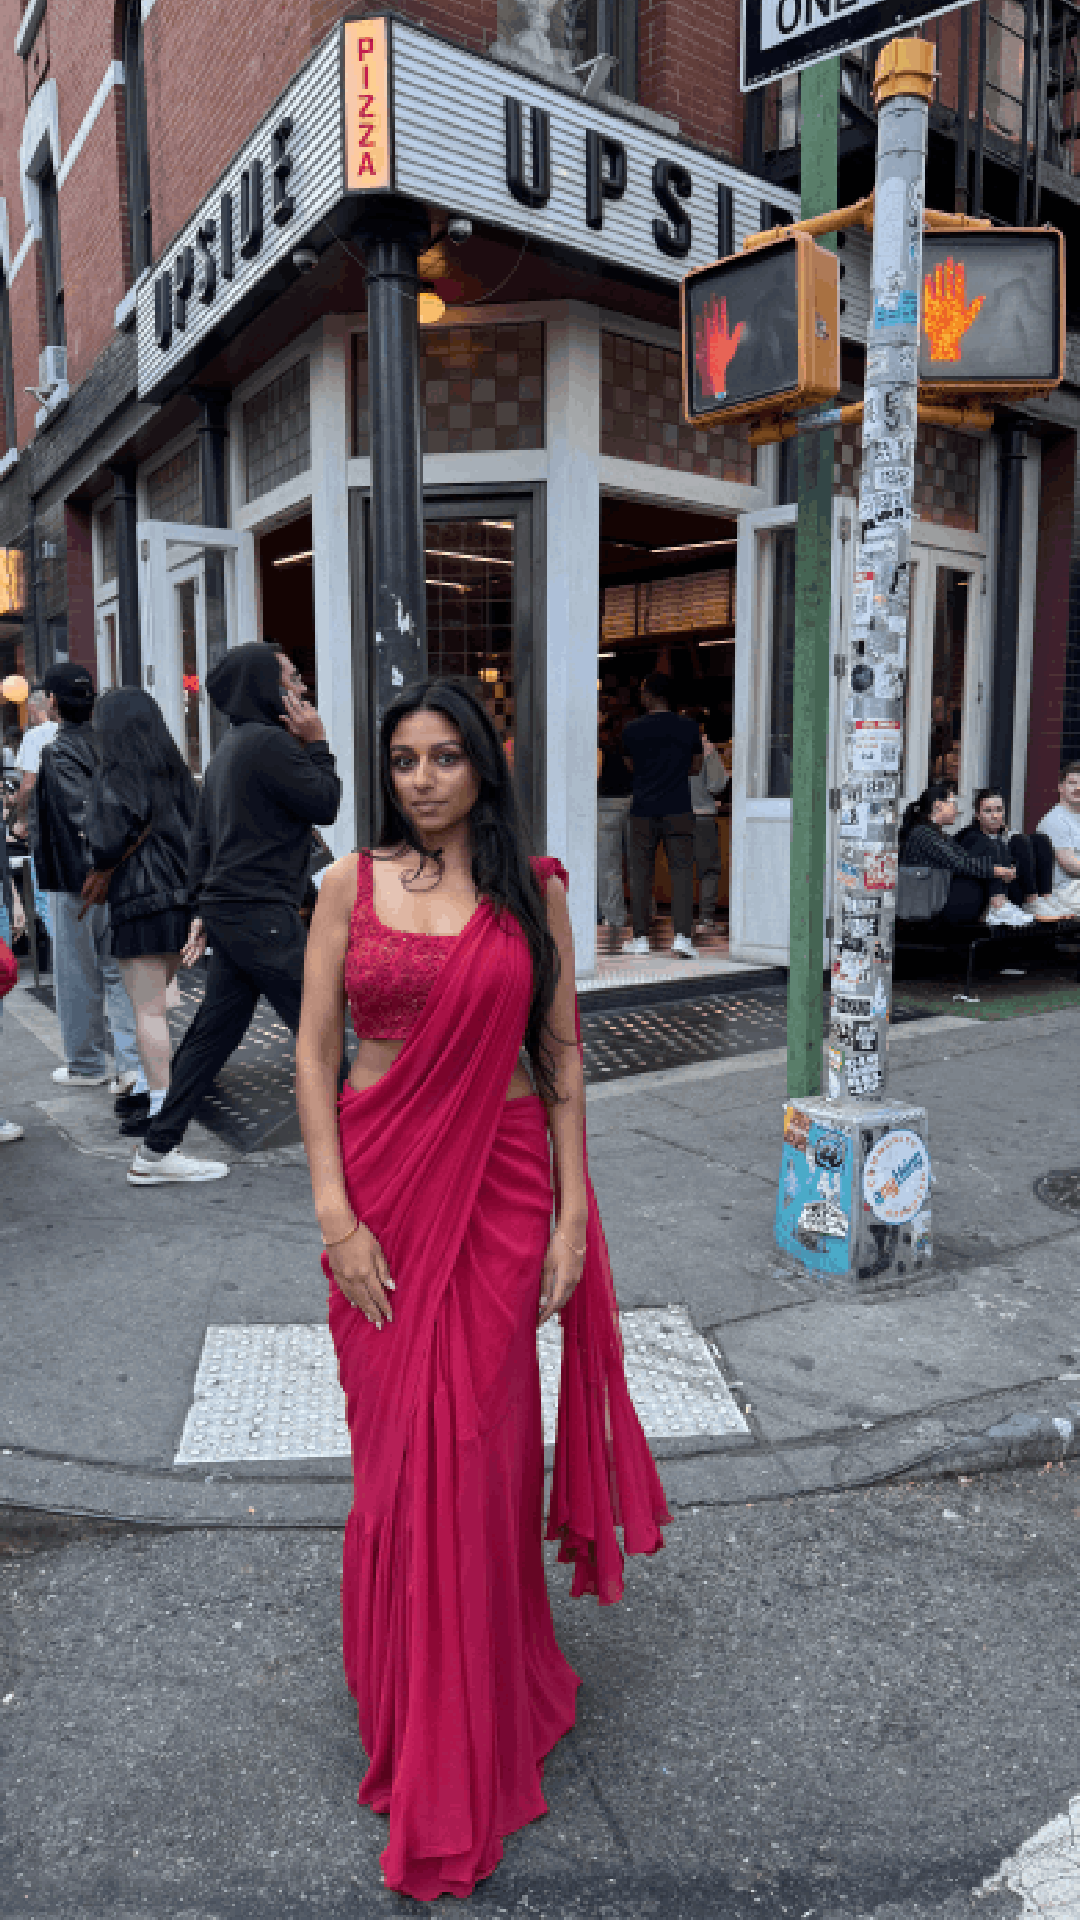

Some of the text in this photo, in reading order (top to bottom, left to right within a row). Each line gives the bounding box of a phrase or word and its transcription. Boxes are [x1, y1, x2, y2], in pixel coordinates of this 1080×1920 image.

[357, 36, 377, 176] PIZZA
[505, 95, 845, 316] UPSI
[154, 117, 296, 351] UPSIDE
